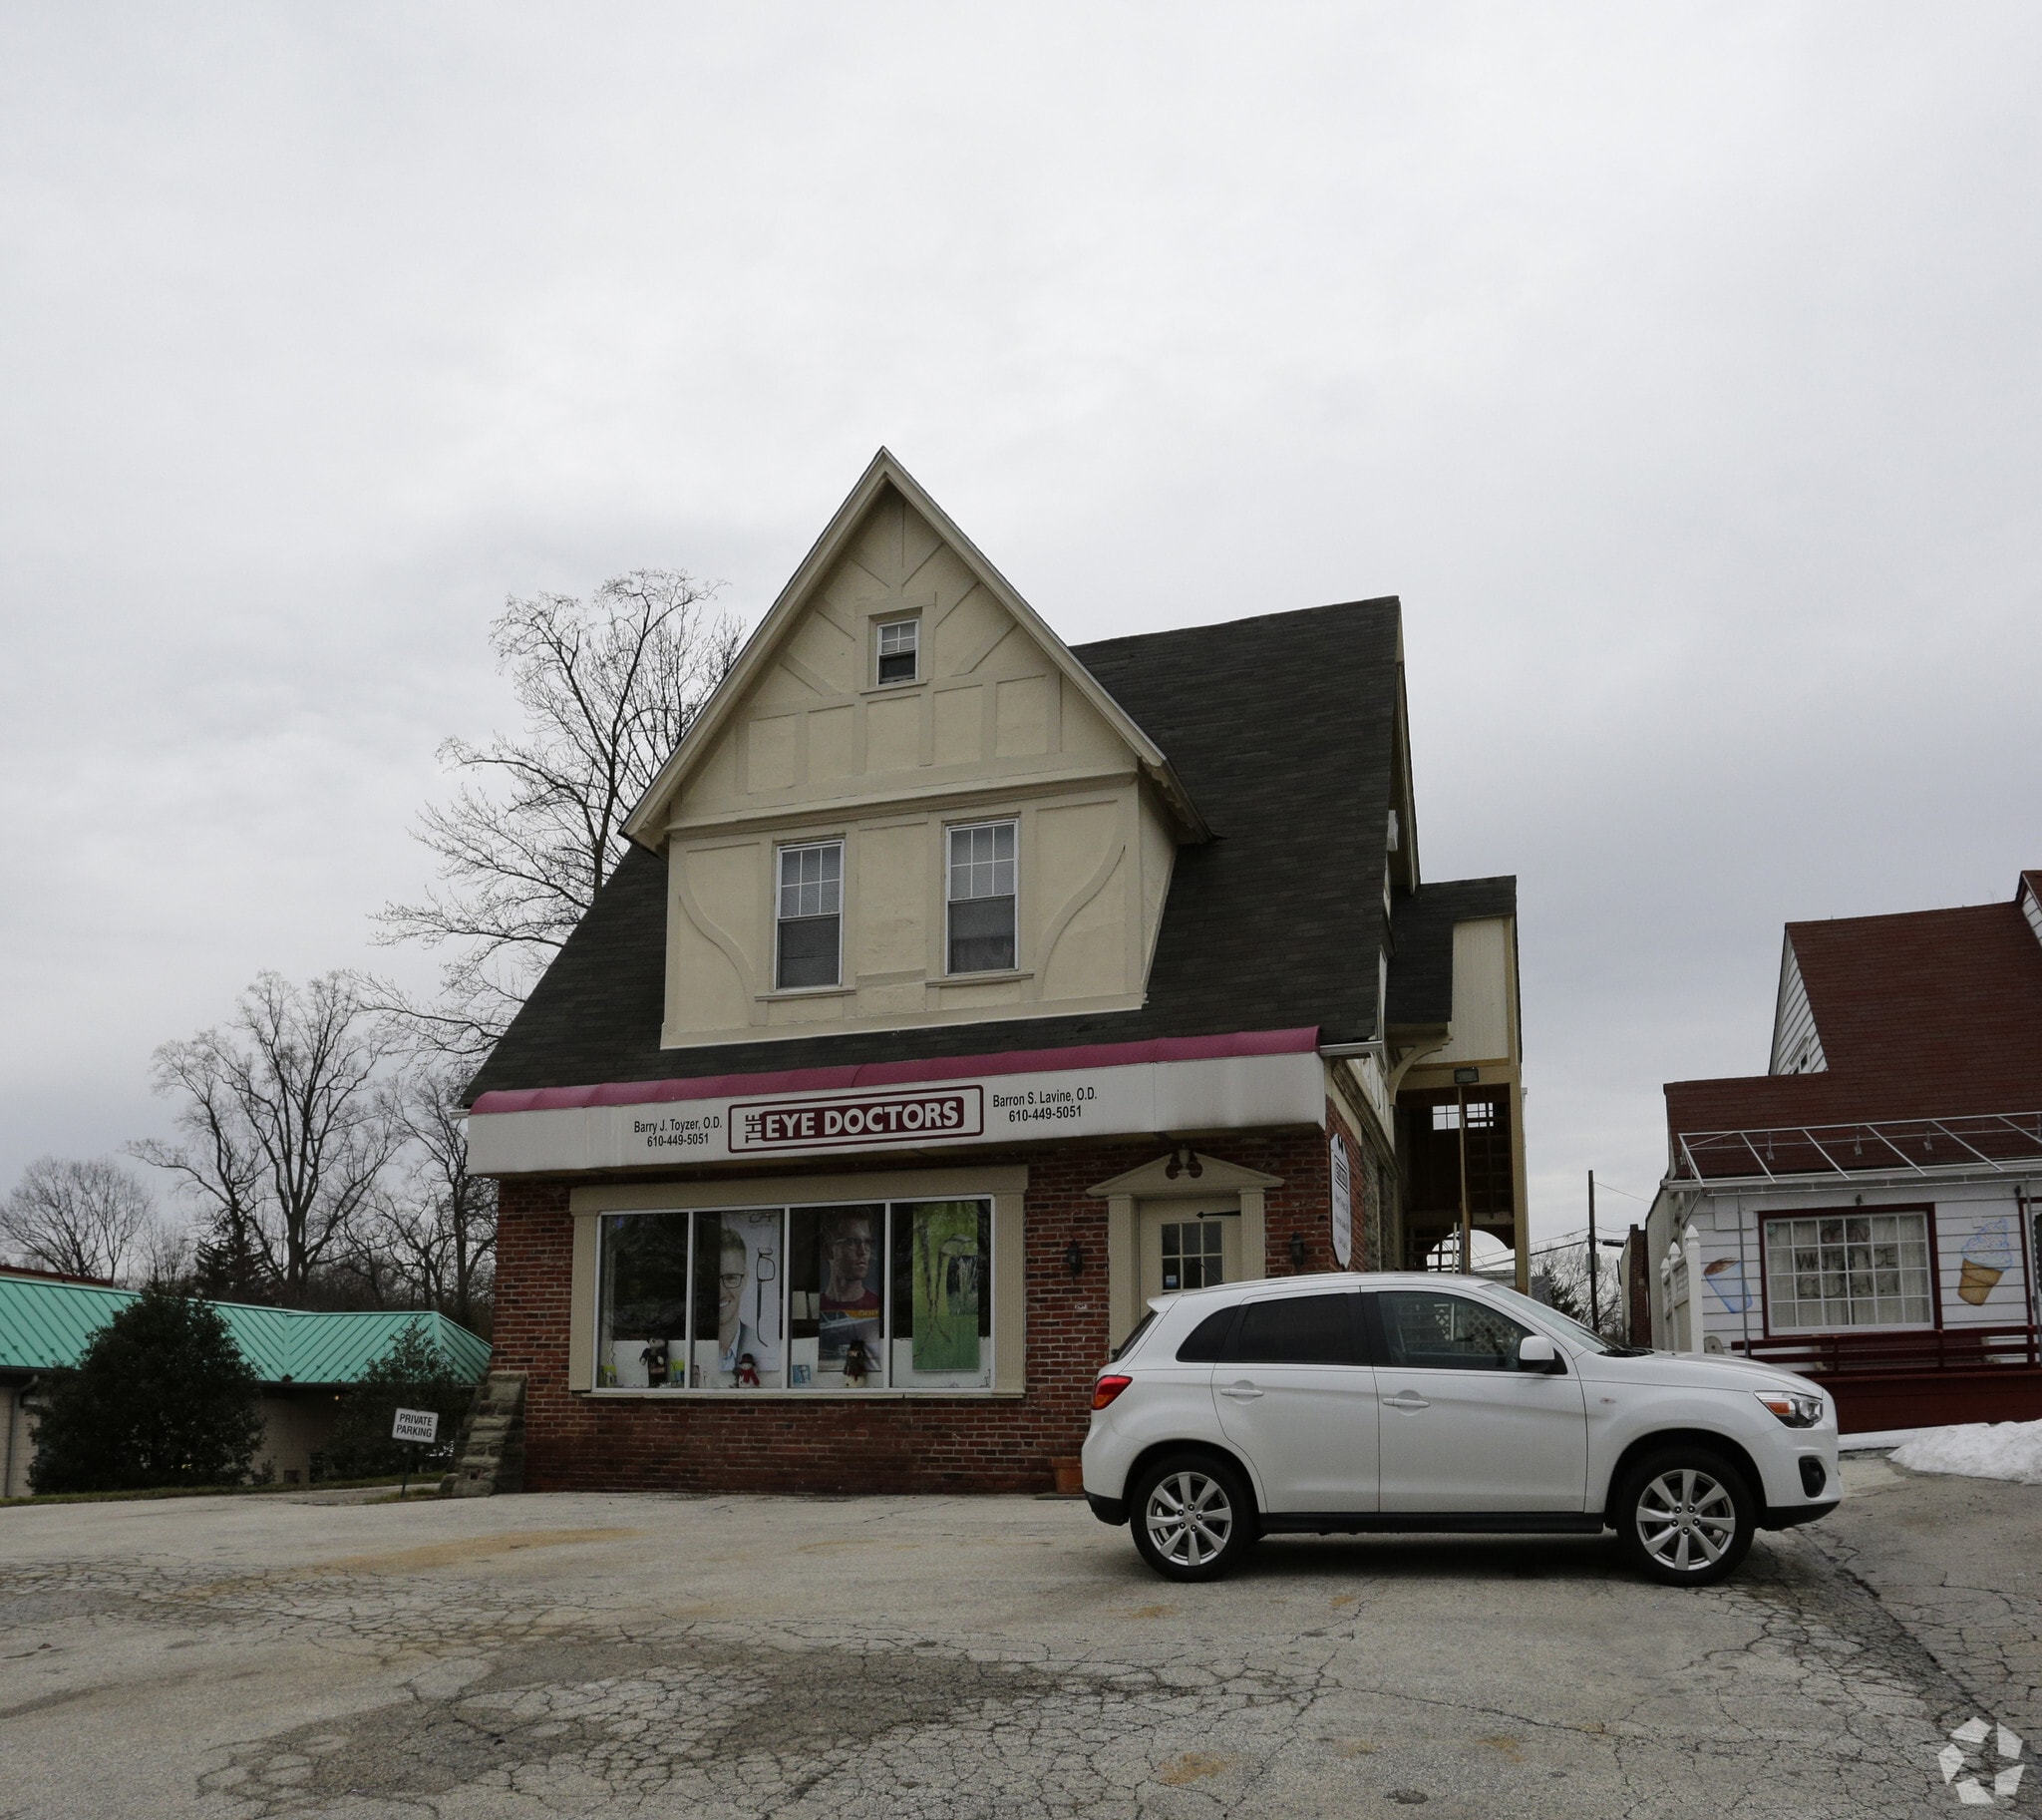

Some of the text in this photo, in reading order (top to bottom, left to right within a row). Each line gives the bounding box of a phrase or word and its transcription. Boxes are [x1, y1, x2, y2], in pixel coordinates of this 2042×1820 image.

[992, 1086, 1098, 1108] Barron S. Lavine, O.D.
[745, 1100, 958, 1144] THE EYE DOCTORS
[1009, 1104, 1082, 1122] 610-449-5051
[634, 1116, 723, 1135] Barry J. Toyzer, O.D.
[647, 1133, 709, 1147] 610-449-5051
[399, 1413, 433, 1426] PRIVATE
[396, 1424, 433, 1438] PARKING
